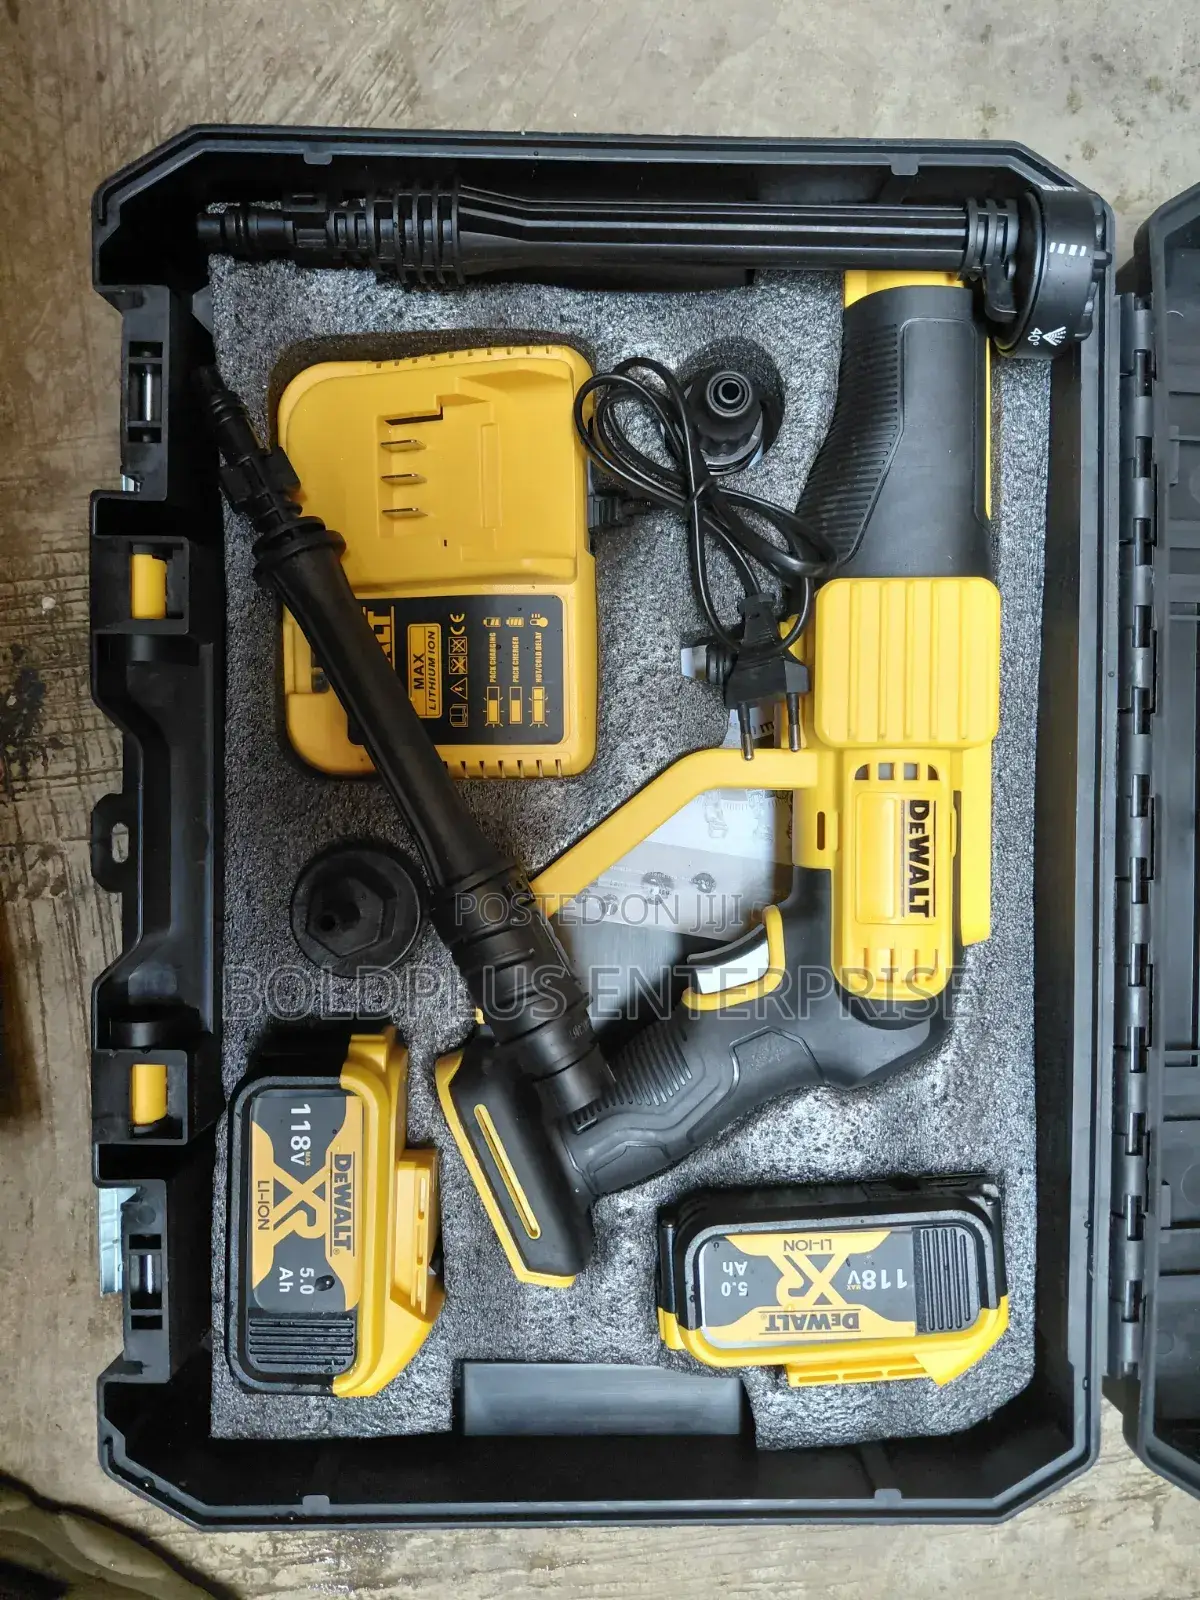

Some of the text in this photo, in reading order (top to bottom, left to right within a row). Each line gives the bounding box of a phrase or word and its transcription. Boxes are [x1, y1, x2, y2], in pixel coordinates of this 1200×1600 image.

[1027, 327, 1043, 346] 40°
[427, 631, 437, 711] LITHIUM ION
[489, 632, 497, 683] PACK CHARGING
[413, 653, 425, 690] MAX
[512, 666, 520, 683] PACK
[909, 799, 930, 918] DEWALT
[257, 1180, 270, 1231] LI-ION
[783, 1239, 832, 1251] LI-ION
[279, 1266, 294, 1292] Ah
[300, 1267, 315, 1295] 5.0
[722, 1261, 748, 1277] Ah
[721, 1281, 748, 1297] 5.0
